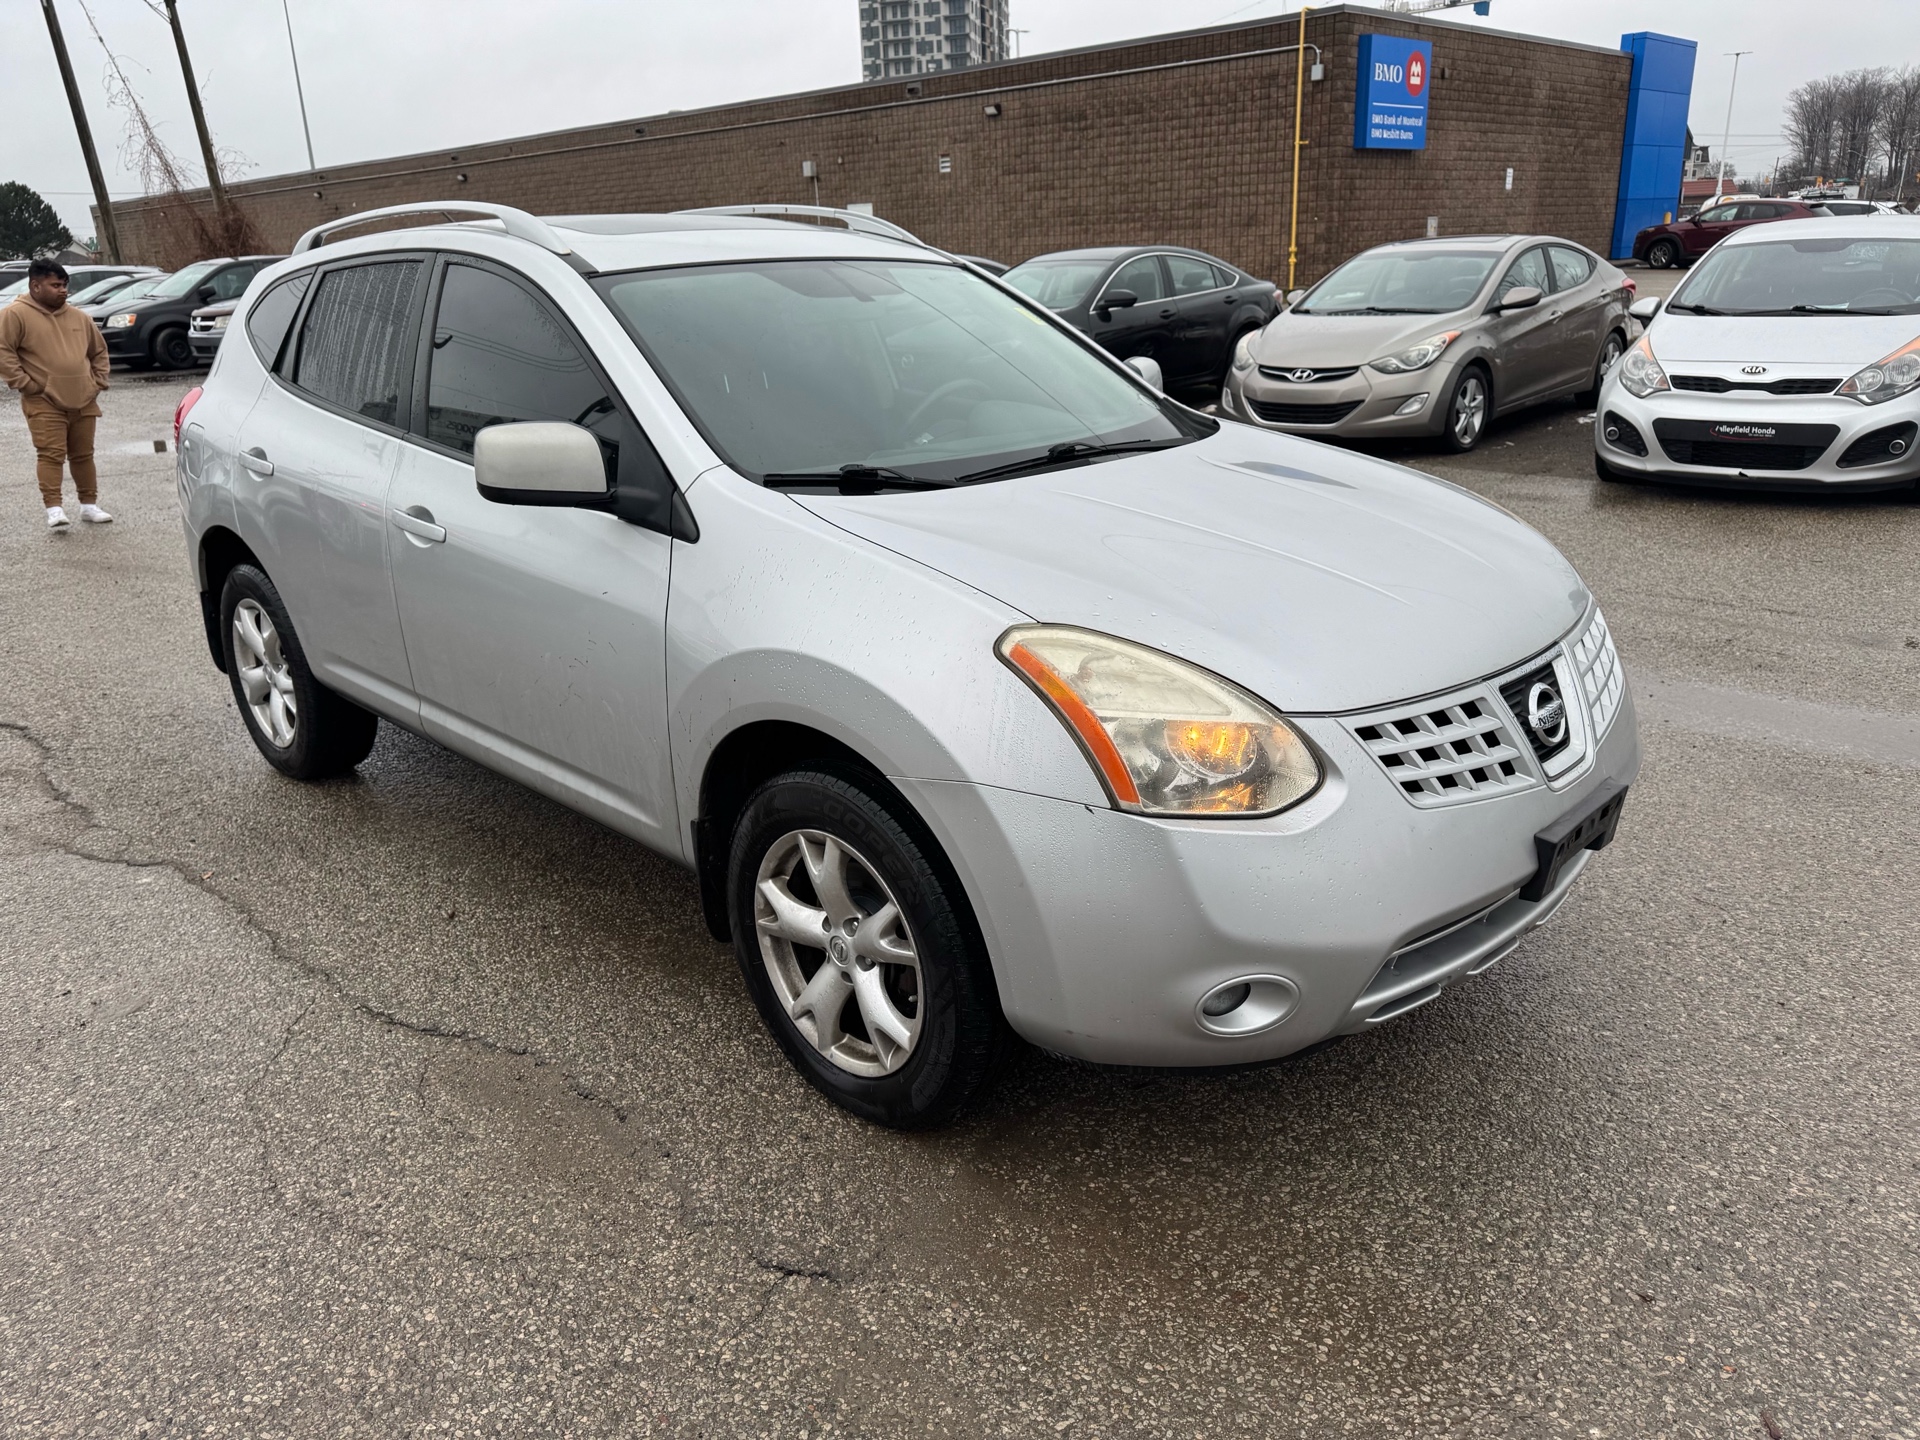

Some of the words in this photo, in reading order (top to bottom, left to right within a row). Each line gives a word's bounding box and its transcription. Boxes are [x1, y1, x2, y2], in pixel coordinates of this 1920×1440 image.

[1374, 62, 1403, 83] BMO
[1372, 114, 1383, 124] BMO
[1384, 114, 1396, 125] Bank
[1397, 115, 1403, 125] of
[1403, 116, 1423, 127] Montreal
[1371, 128, 1382, 138] BMO
[1400, 130, 1413, 140] Burns
[1752, 426, 1776, 435] Honda
